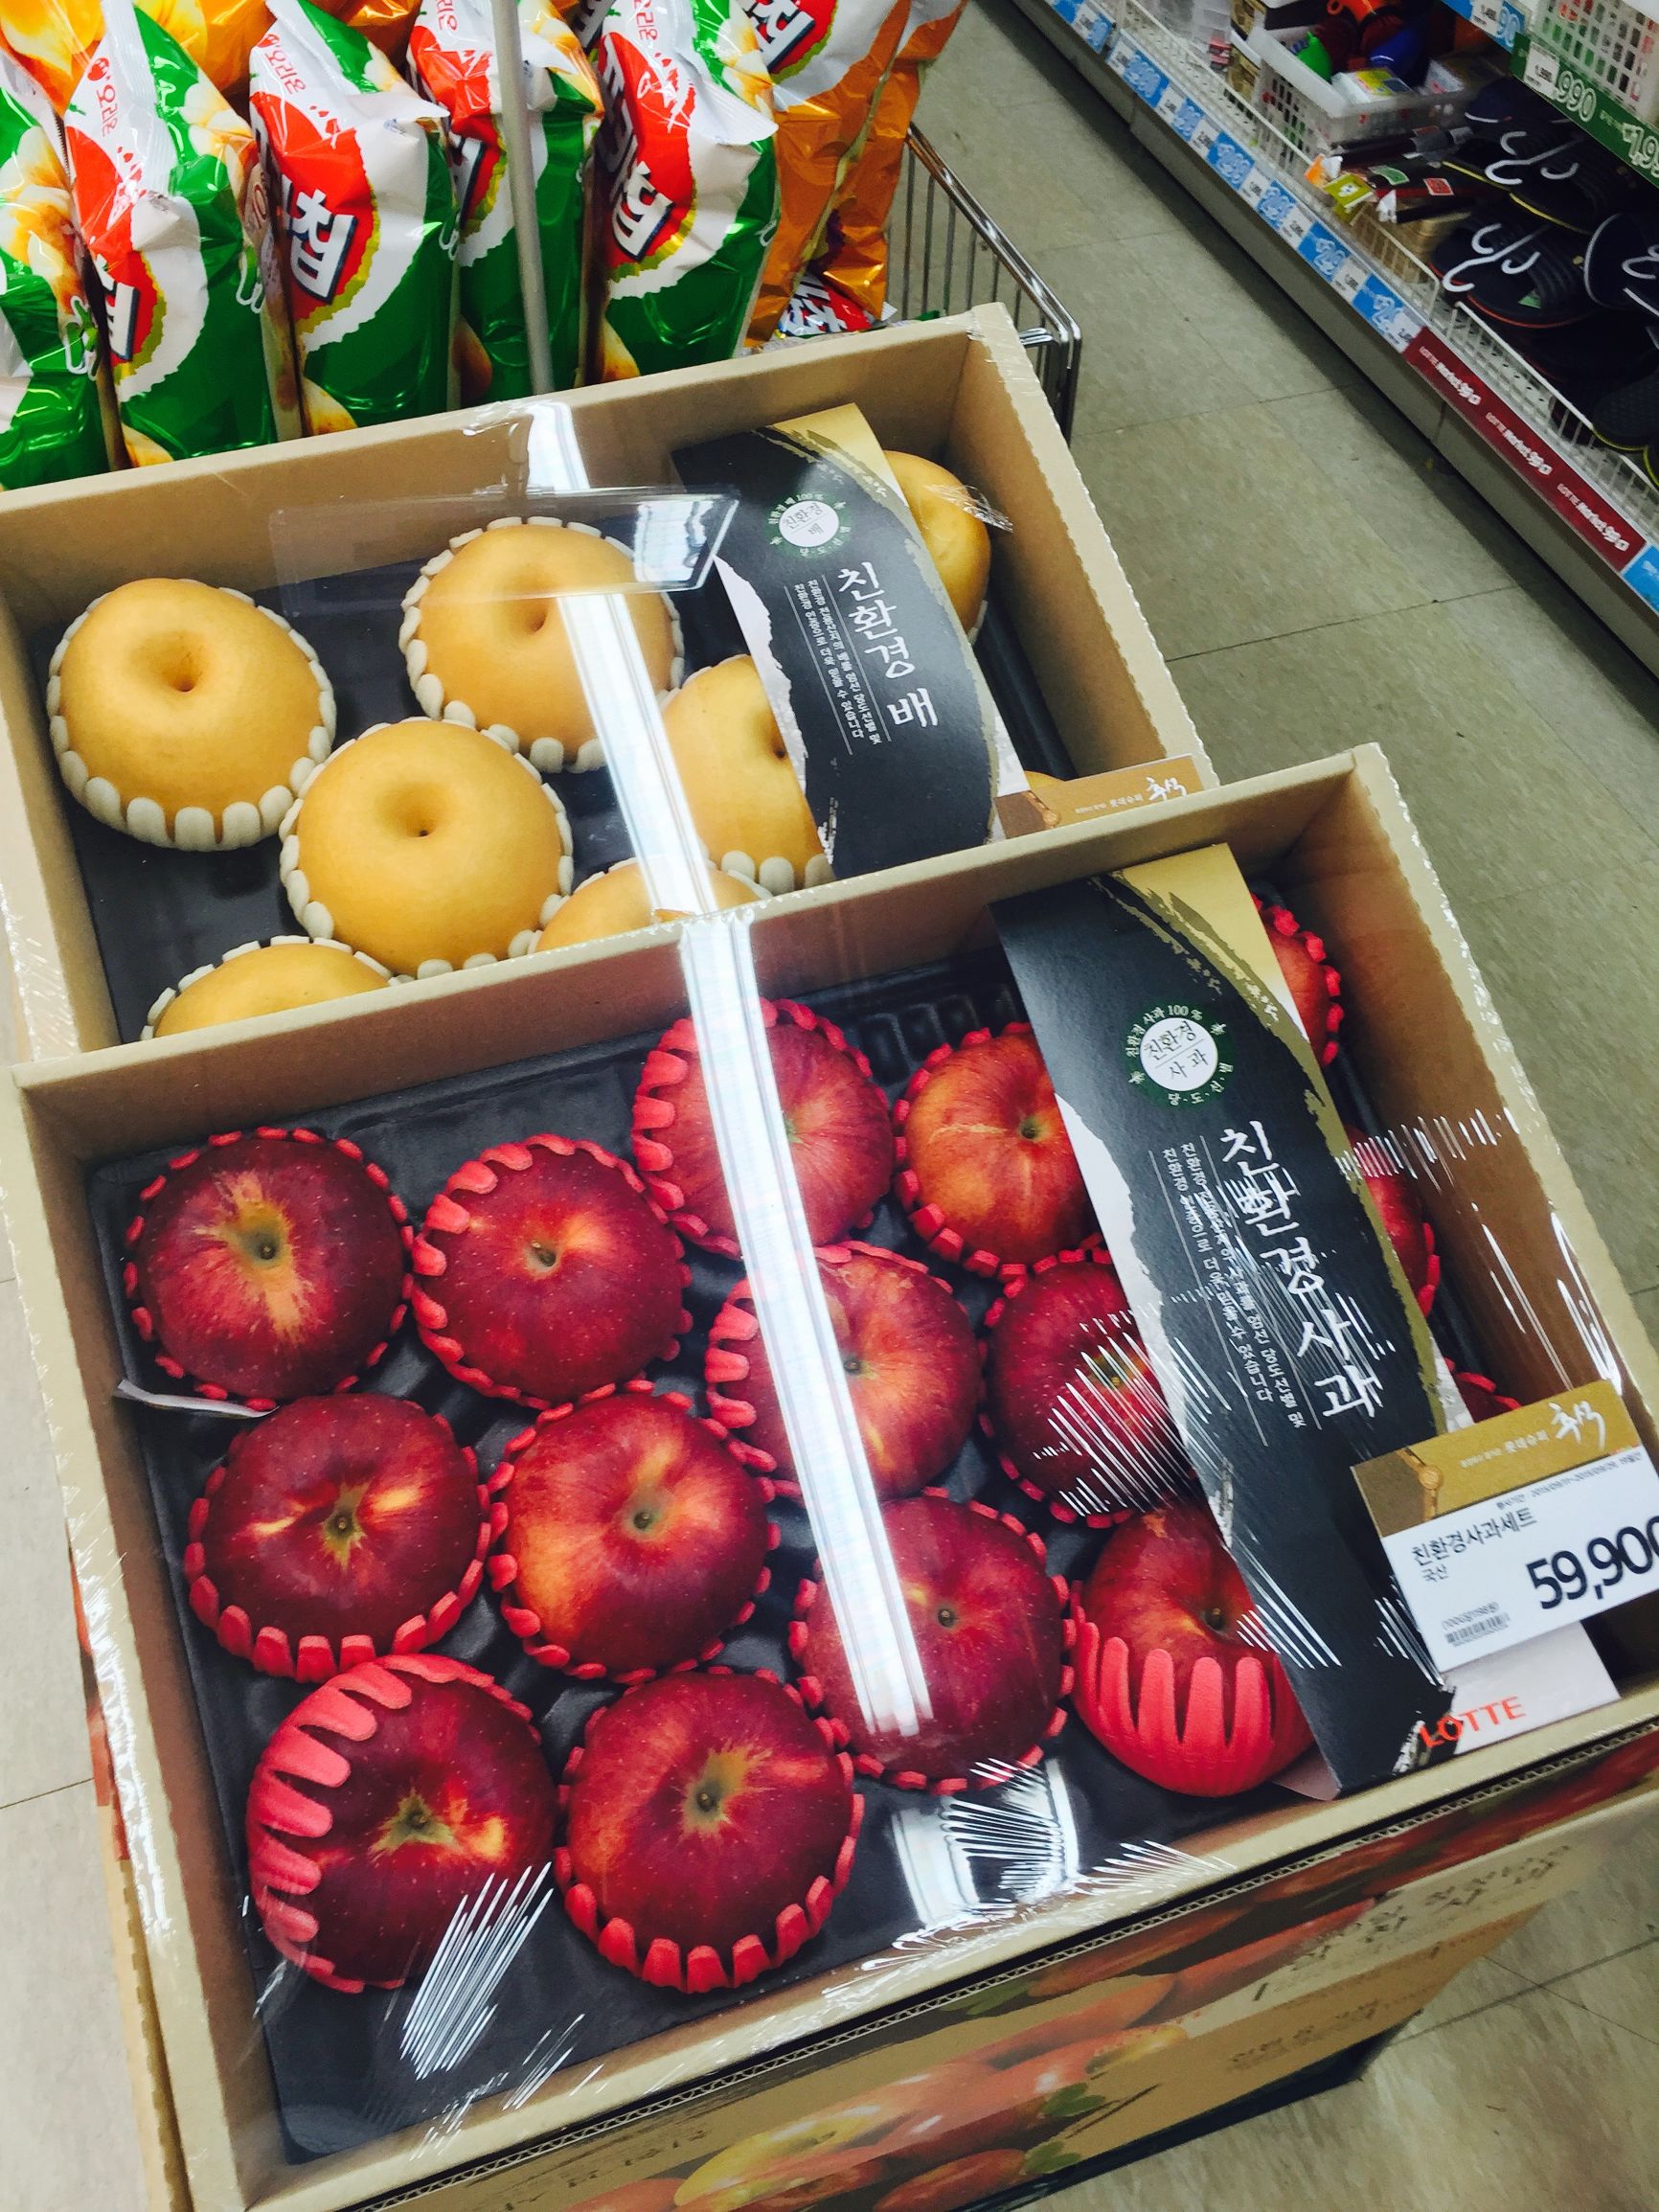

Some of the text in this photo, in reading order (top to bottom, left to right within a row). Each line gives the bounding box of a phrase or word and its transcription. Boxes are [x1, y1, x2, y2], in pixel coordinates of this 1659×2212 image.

[267, 47, 307, 94] 오리온
[783, 502, 824, 530] 친환경
[837, 561, 939, 728] 친환경 배
[836, 690, 850, 699] 수
[841, 700, 864, 739] 있습니다
[1143, 1006, 1167, 1025] 사과
[1168, 1004, 1190, 1016] 100
[1144, 1020, 1197, 1061] 친환경
[1162, 1148, 1189, 1192] 친환경
[1179, 1142, 1208, 1186] 친환경
[1246, 1312, 1271, 1345] 엄선
[1287, 1411, 1307, 1428] 및
[1220, 1119, 1382, 1419] 친환경 사과
[1230, 1325, 1247, 1339] 수
[1238, 1343, 1274, 1402] 있습니다
[1412, 1506, 1538, 1566] 친환경사과세트
[1422, 1564, 1450, 1584] 국산
[1418, 1695, 1527, 1749] LOTTE
